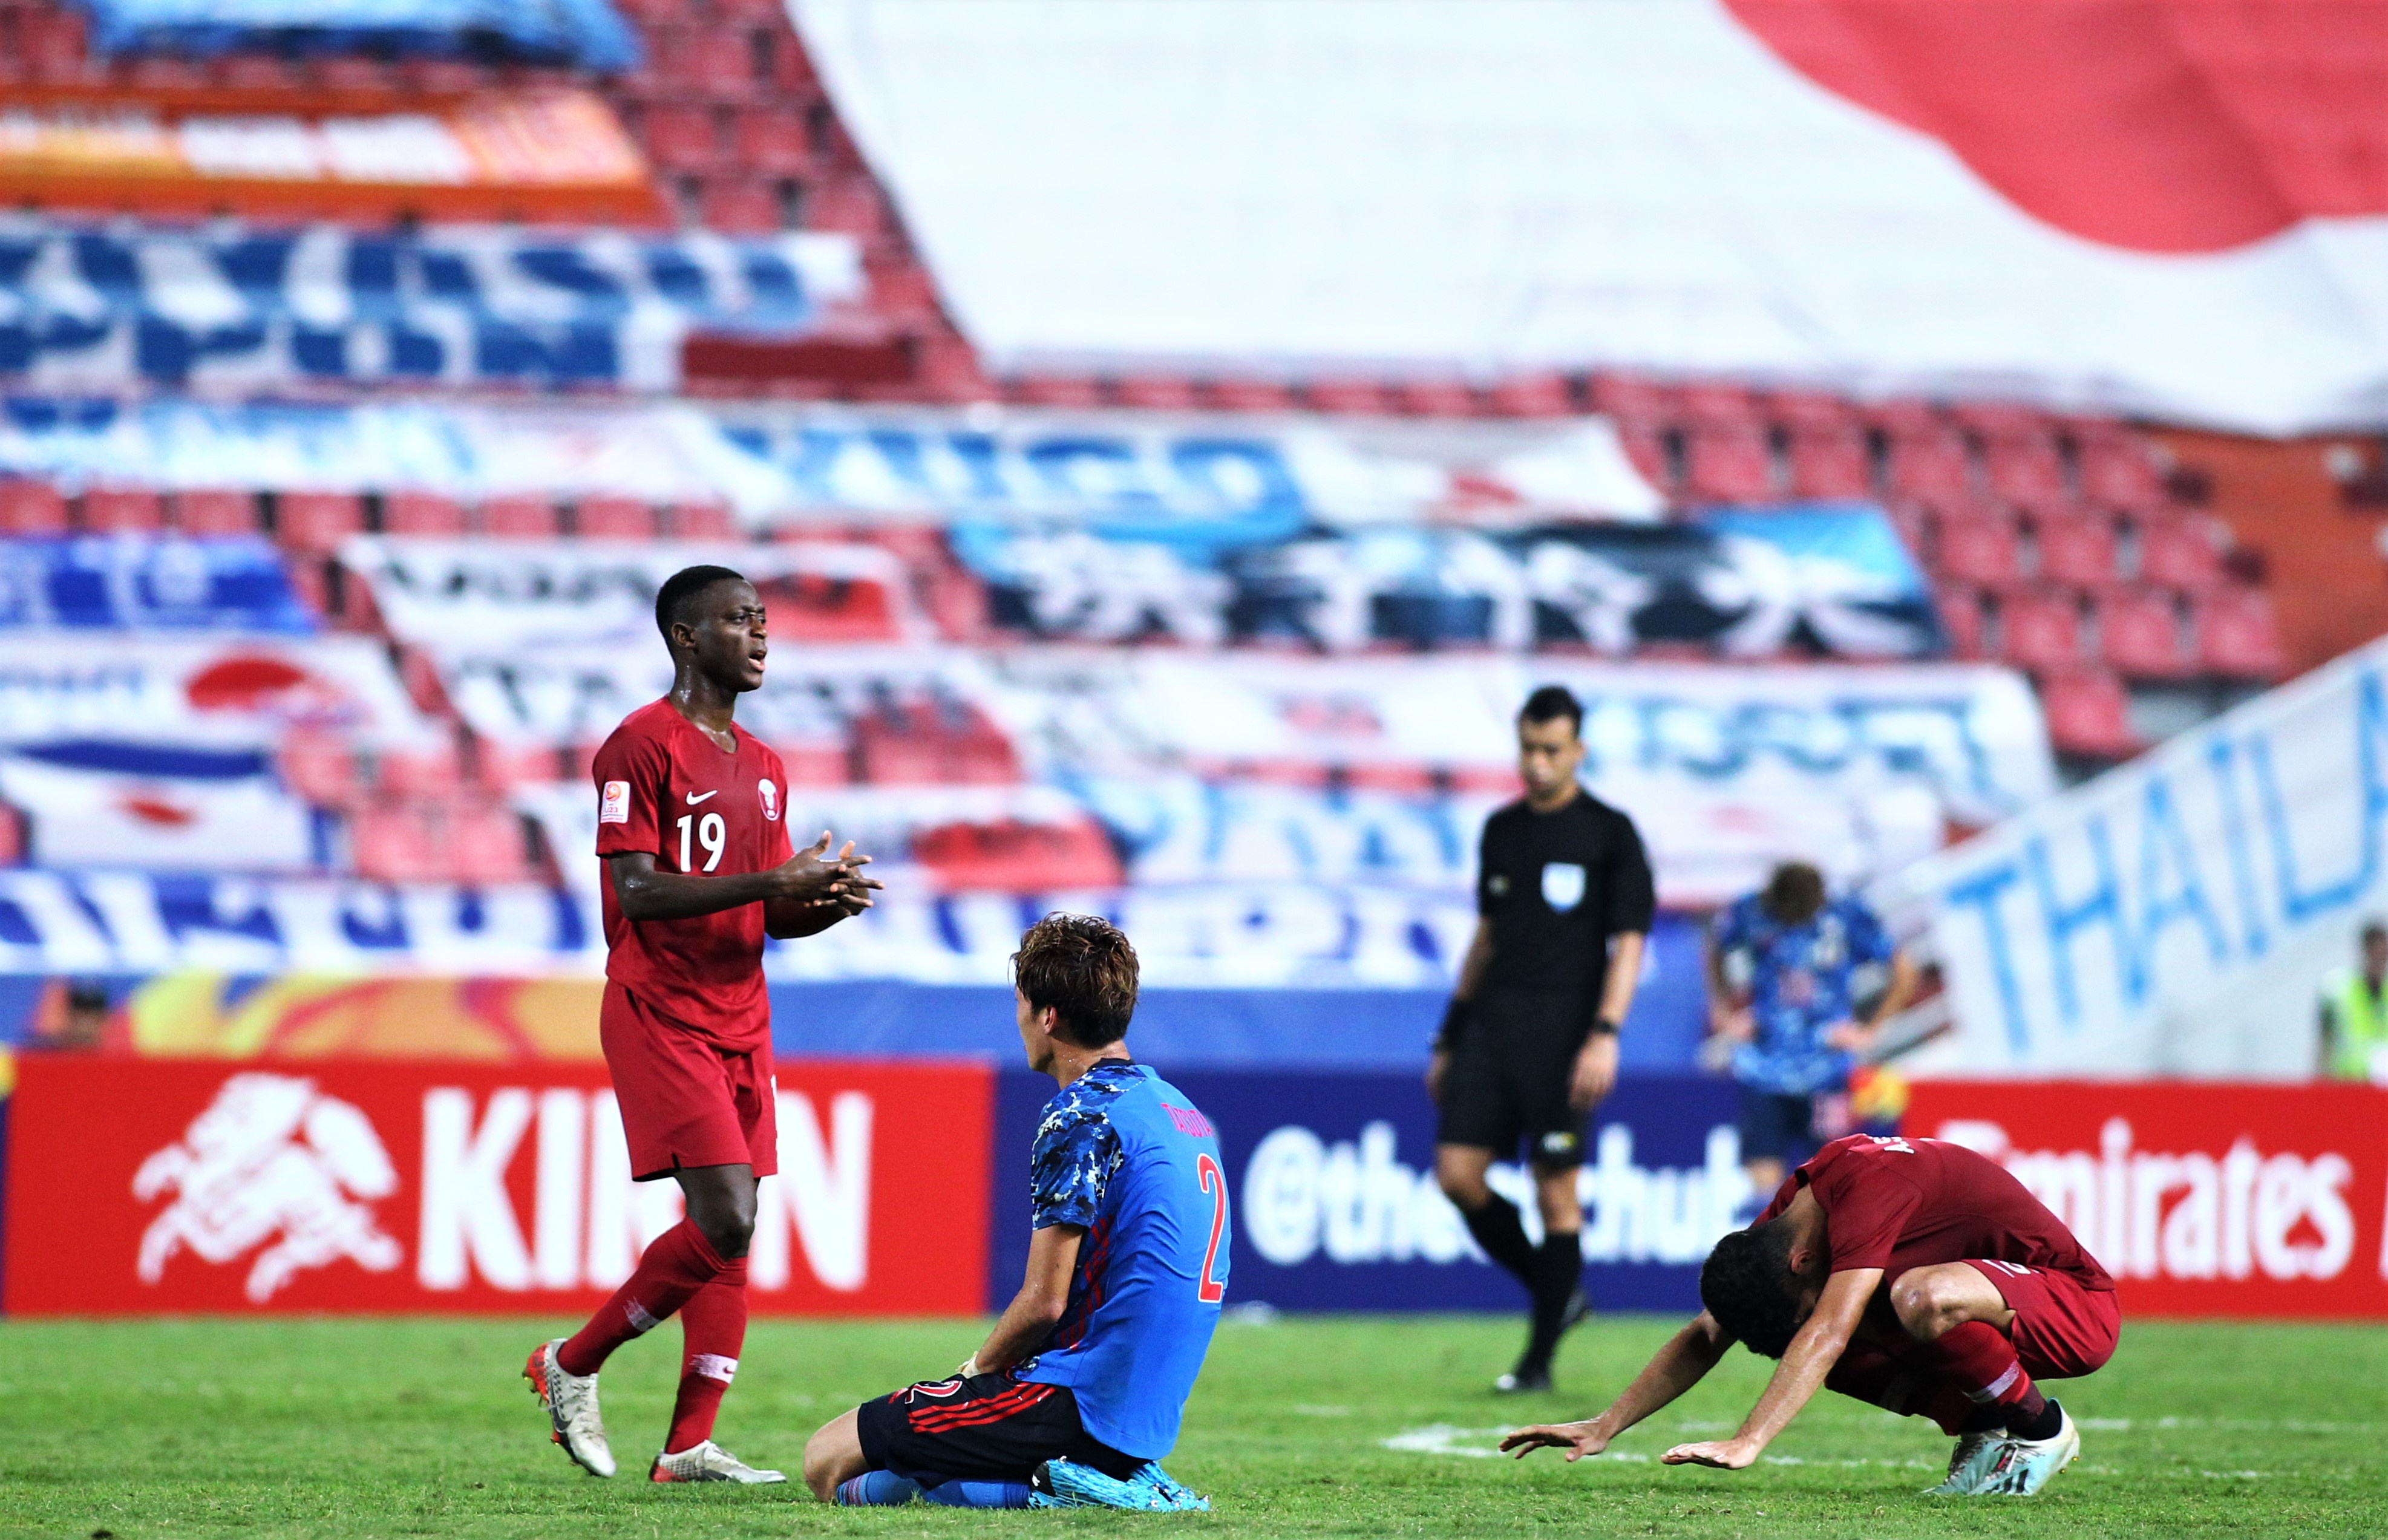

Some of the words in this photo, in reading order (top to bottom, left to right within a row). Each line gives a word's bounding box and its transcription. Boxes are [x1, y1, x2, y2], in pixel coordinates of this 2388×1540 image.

[676, 812, 726, 872] 19
[417, 1088, 874, 1291] KIRN
[1197, 1153, 1226, 1303] 2
[1938, 1116, 2355, 1281] mirates
